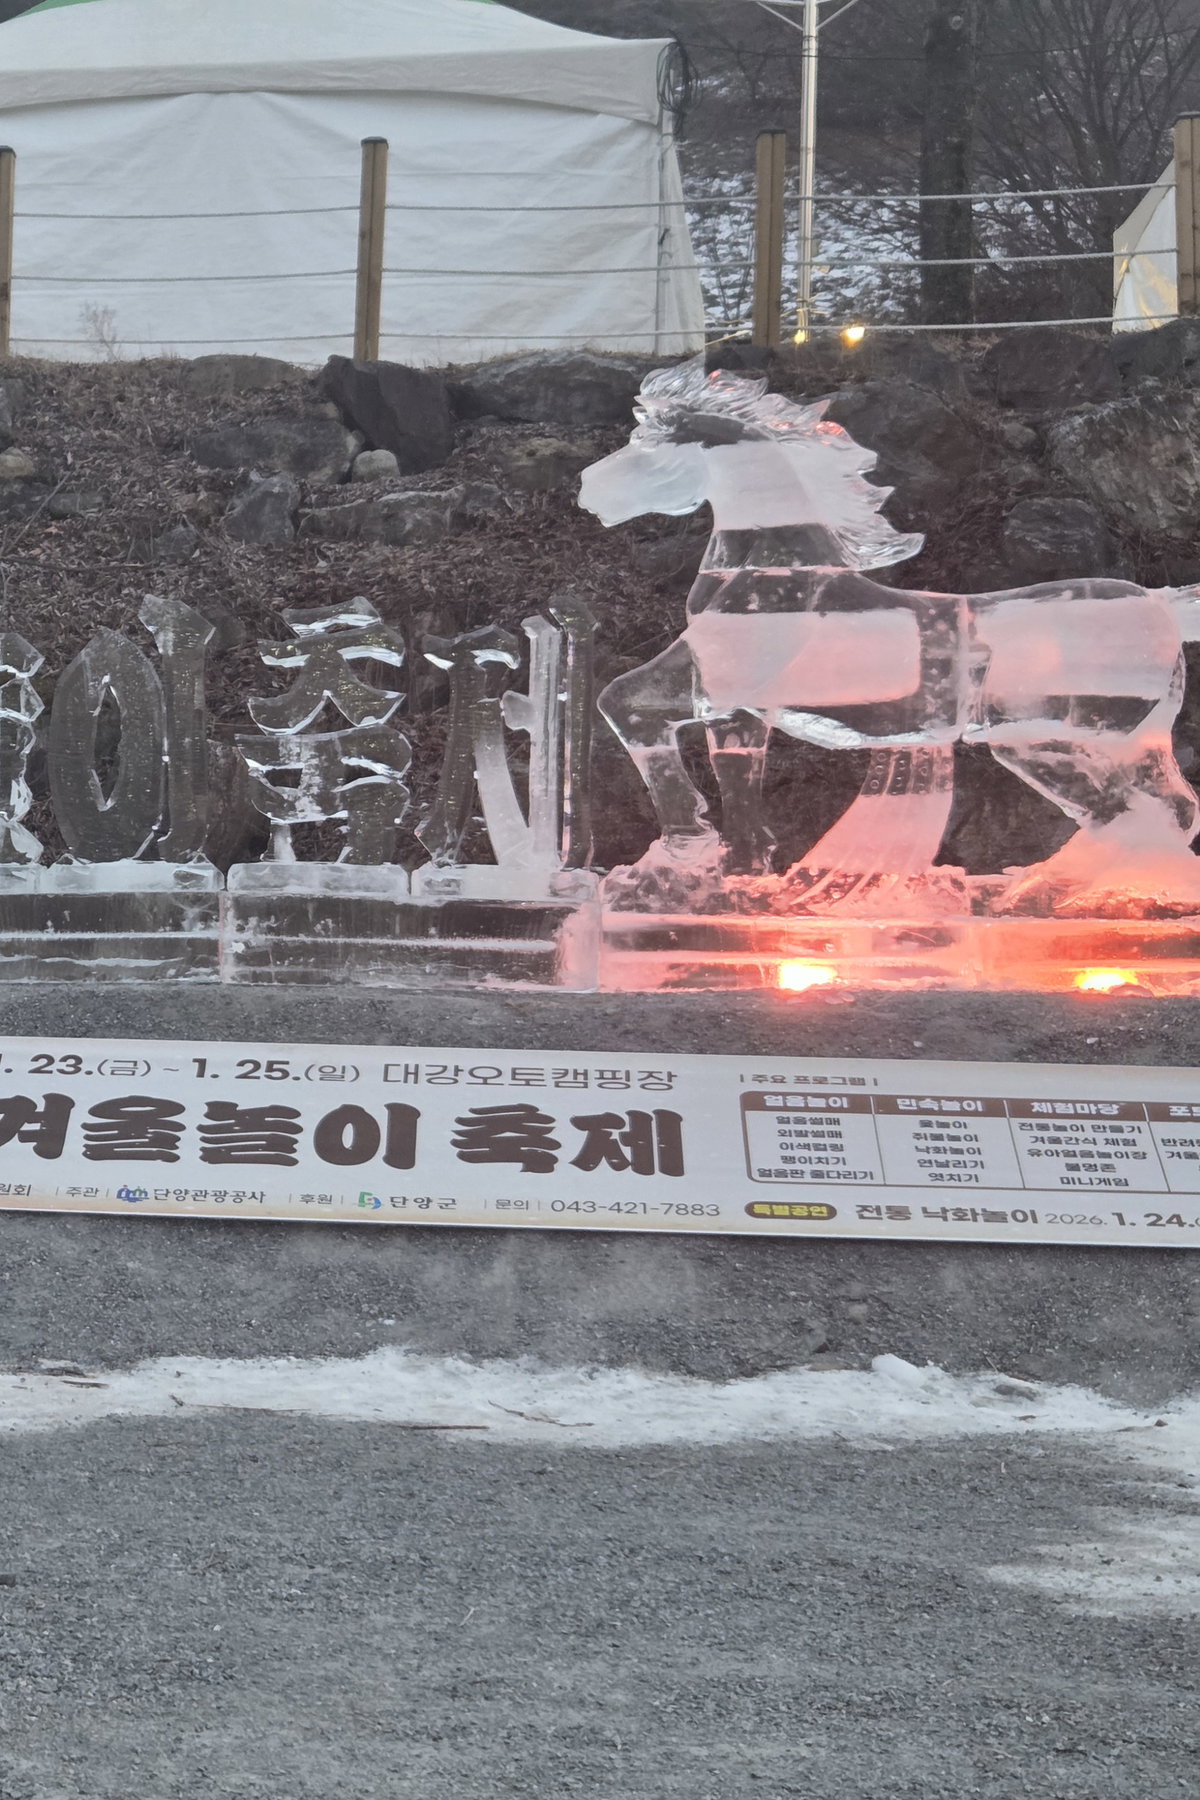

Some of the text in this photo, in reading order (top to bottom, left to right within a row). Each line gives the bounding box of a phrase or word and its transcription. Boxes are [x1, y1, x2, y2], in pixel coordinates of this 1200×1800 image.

[192, 1057, 219, 1079] 1.
[382, 1062, 678, 1092] 대강오토캠핑장
[752, 1074, 867, 1086] 주요 프로그램
[763, 1094, 849, 1109] 얼음놀이
[896, 1098, 984, 1112] 민속놀이
[1031, 1101, 1121, 1115] 체험마당
[1018, 1122, 1142, 1134] 전통놀이 만들기
[450, 1103, 685, 1177] 축제
[912, 1132, 979, 1142] 쥐불놀이
[1029, 1136, 1138, 1147] 겨울간식 체험
[1161, 1138, 1200, 1147] 반려
[914, 1145, 982, 1155] 낙화놀이
[1027, 1148, 1148, 1160] 유아얼음놀이장
[917, 1158, 985, 1169] 연날리기
[757, 1168, 874, 1181] 얼음판 줄다리기
[928, 1172, 980, 1183] 엿치기
[1059, 1176, 1129, 1187] 미니게임
[65, 1186, 100, 1198] 주관
[152, 1187, 266, 1204] 단양관광공사
[299, 1193, 333, 1206] 후원
[388, 1195, 458, 1211] 단양군
[495, 1199, 721, 1217] 문의 043-421-7883
[752, 1203, 829, 1217] 특별공연
[856, 1205, 912, 1221] 전통
[921, 1206, 1038, 1224] 낙화놀이
[1045, 1213, 1108, 1225] 2026.
[1112, 1212, 1136, 1227] 1.
